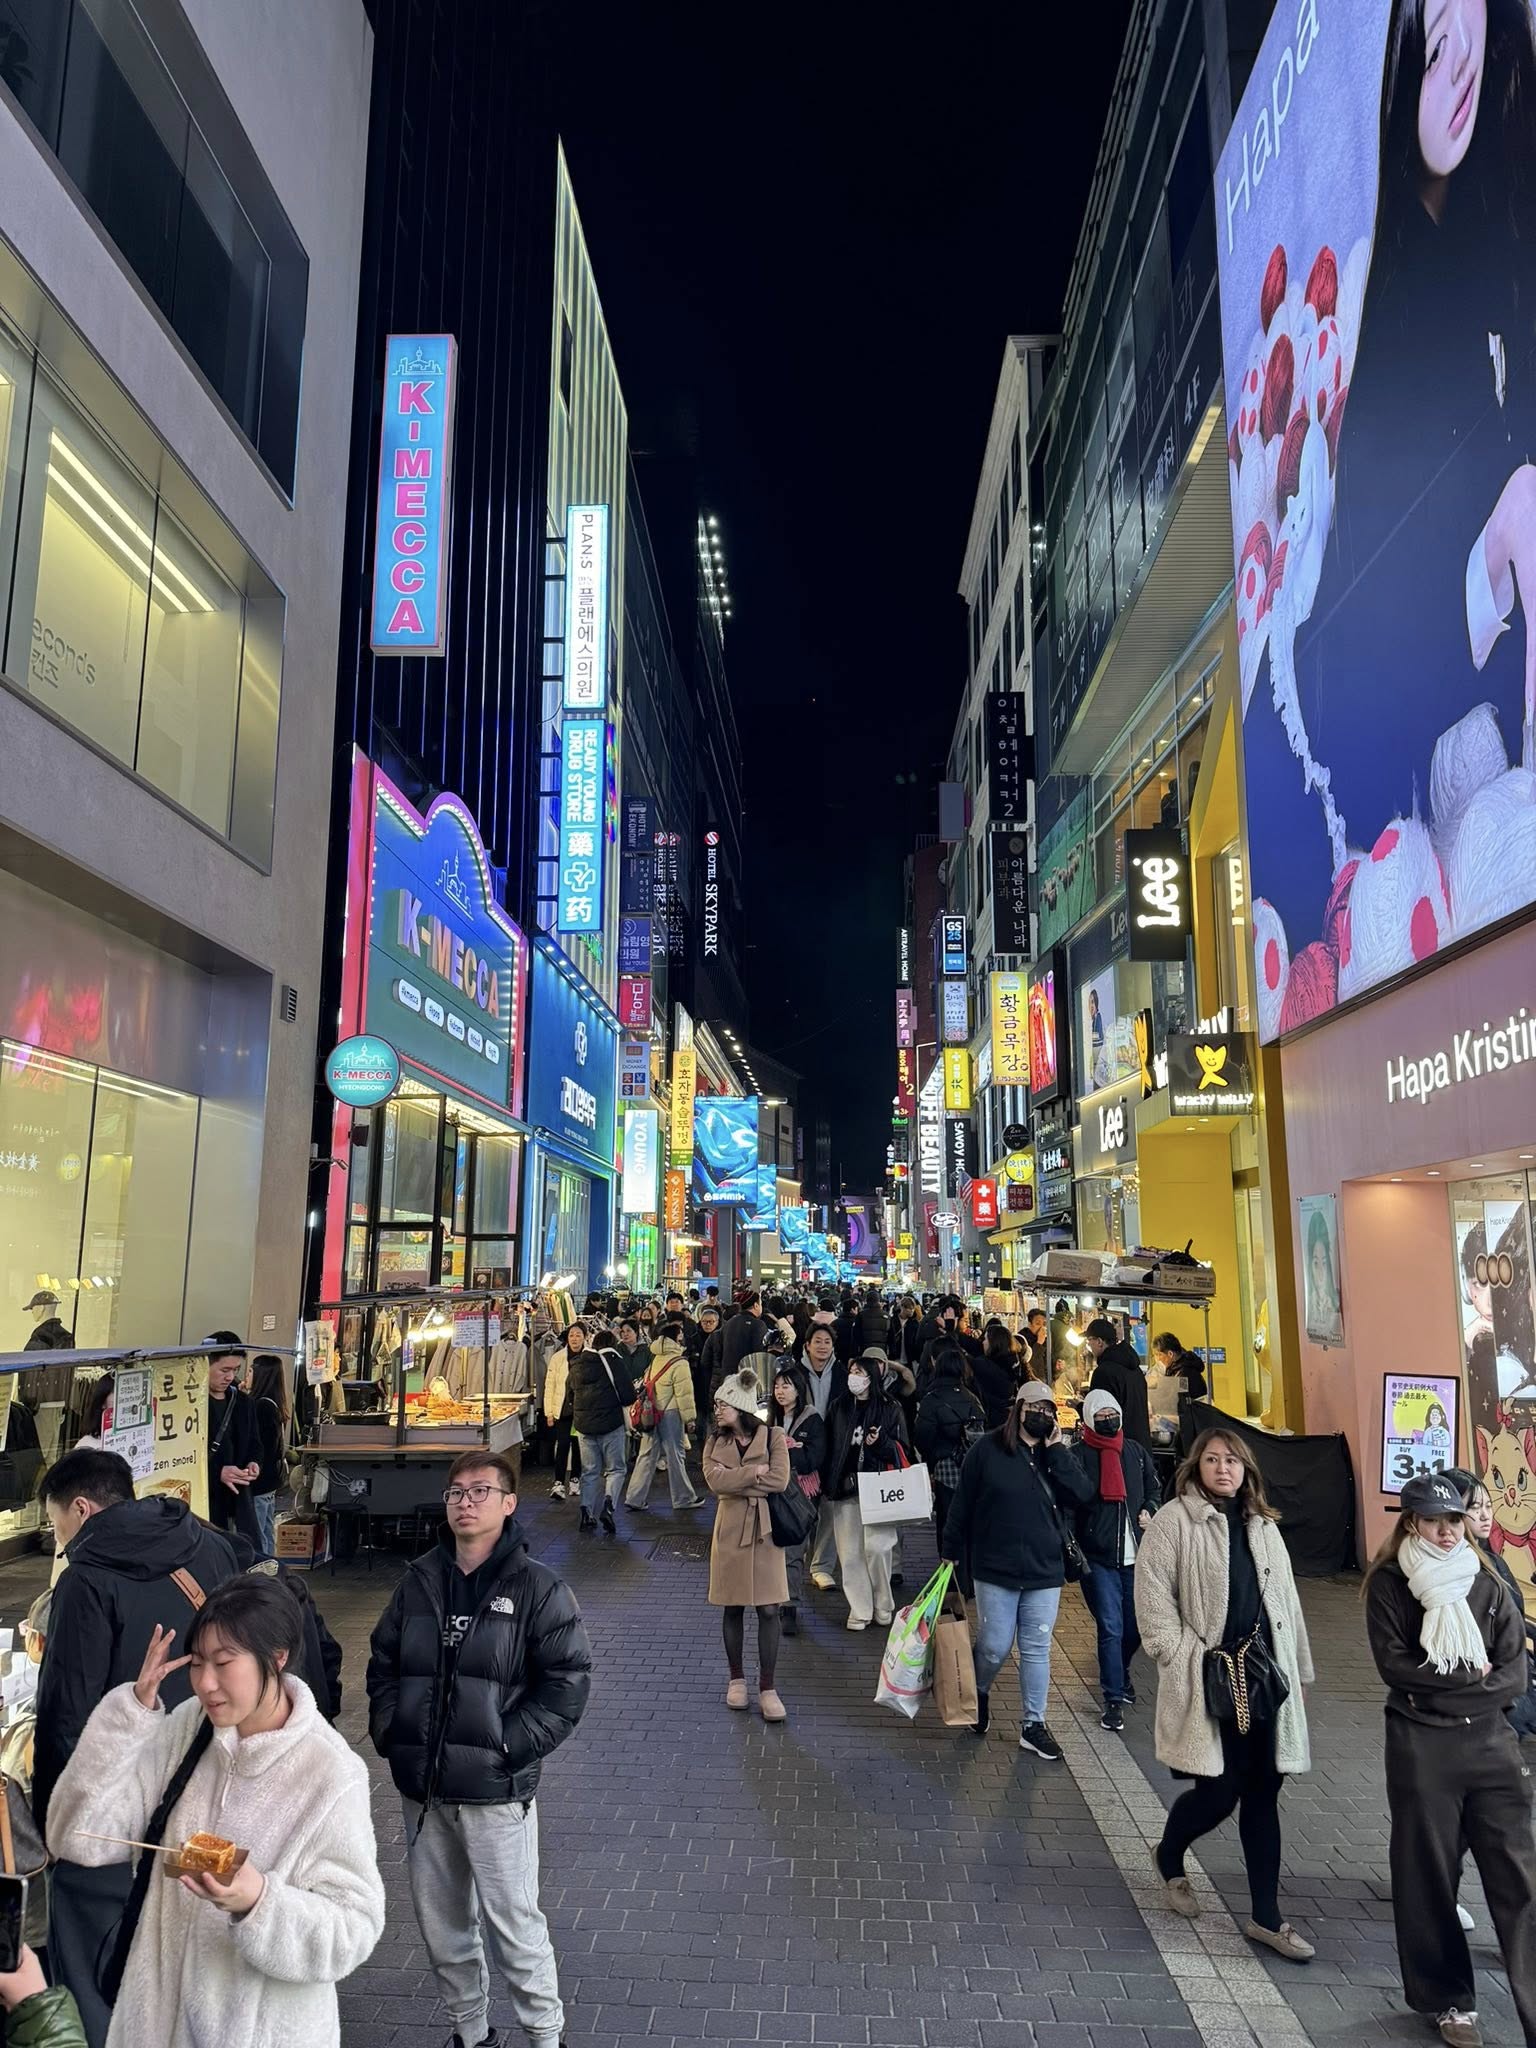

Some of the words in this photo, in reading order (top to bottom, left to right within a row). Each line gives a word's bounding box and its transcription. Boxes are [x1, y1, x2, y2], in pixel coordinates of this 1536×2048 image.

[1183, 366, 1201, 426] 4F
[568, 729, 583, 770] DRUG
[583, 728, 598, 774] READY
[583, 775, 598, 823] YOUNG
[1004, 803, 1014, 817] 2
[707, 849, 717, 881] HOTEL
[1011, 857, 1027, 913] 아름다운
[1137, 857, 1181, 929] Lee
[704, 883, 718, 957] SKYPARK
[946, 921, 962, 931] GS
[947, 931, 962, 941] 25
[1013, 920, 1028, 948] 나라
[399, 889, 500, 1020] K-MECCA
[1000, 994, 1021, 1071] 황금목장
[333, 1070, 393, 1080] K-MECCA
[1387, 1051, 1450, 1104] Hapa
[954, 1121, 965, 1157] SAVOY
[1098, 1105, 1125, 1153] Lee
[920, 1124, 941, 1194] BEAUTY
[1392, 1454, 1445, 1479] 3+1
[880, 1487, 905, 1503] Lee
